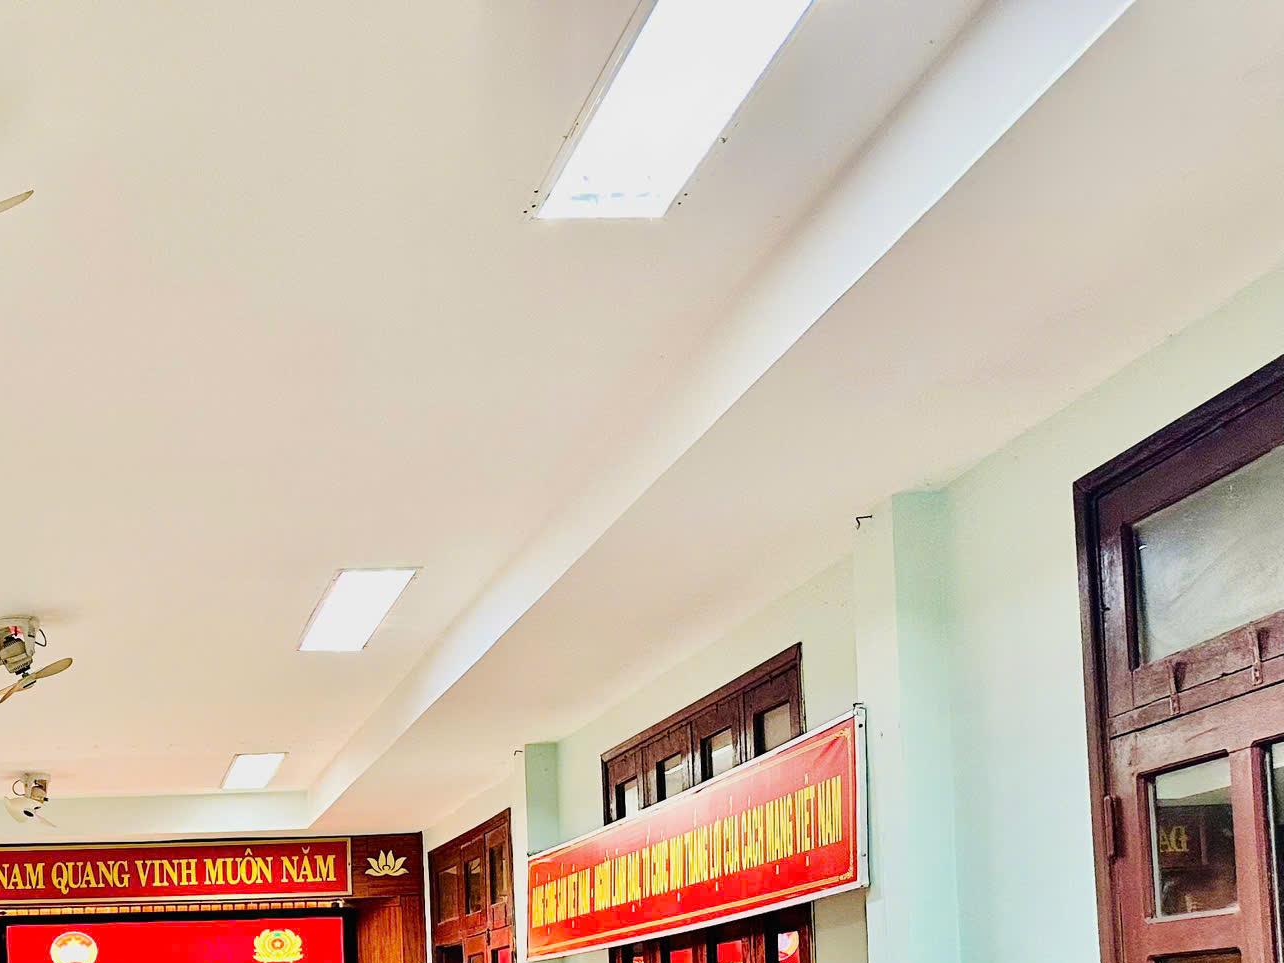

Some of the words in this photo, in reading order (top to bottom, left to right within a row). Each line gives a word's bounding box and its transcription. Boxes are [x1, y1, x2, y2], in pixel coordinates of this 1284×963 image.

[51, 860, 130, 894] QUANG
[135, 857, 198, 887] VINH
[204, 848, 273, 886] MUÔN
[280, 846, 336, 883] NĂM
[709, 816, 722, 891] LỢI
[723, 796, 740, 876] CỦA
[741, 796, 764, 871] CÁCH
[766, 792, 793, 875] MẠNG
[795, 773, 815, 867] VIỆT
[818, 775, 842, 848] NAM
